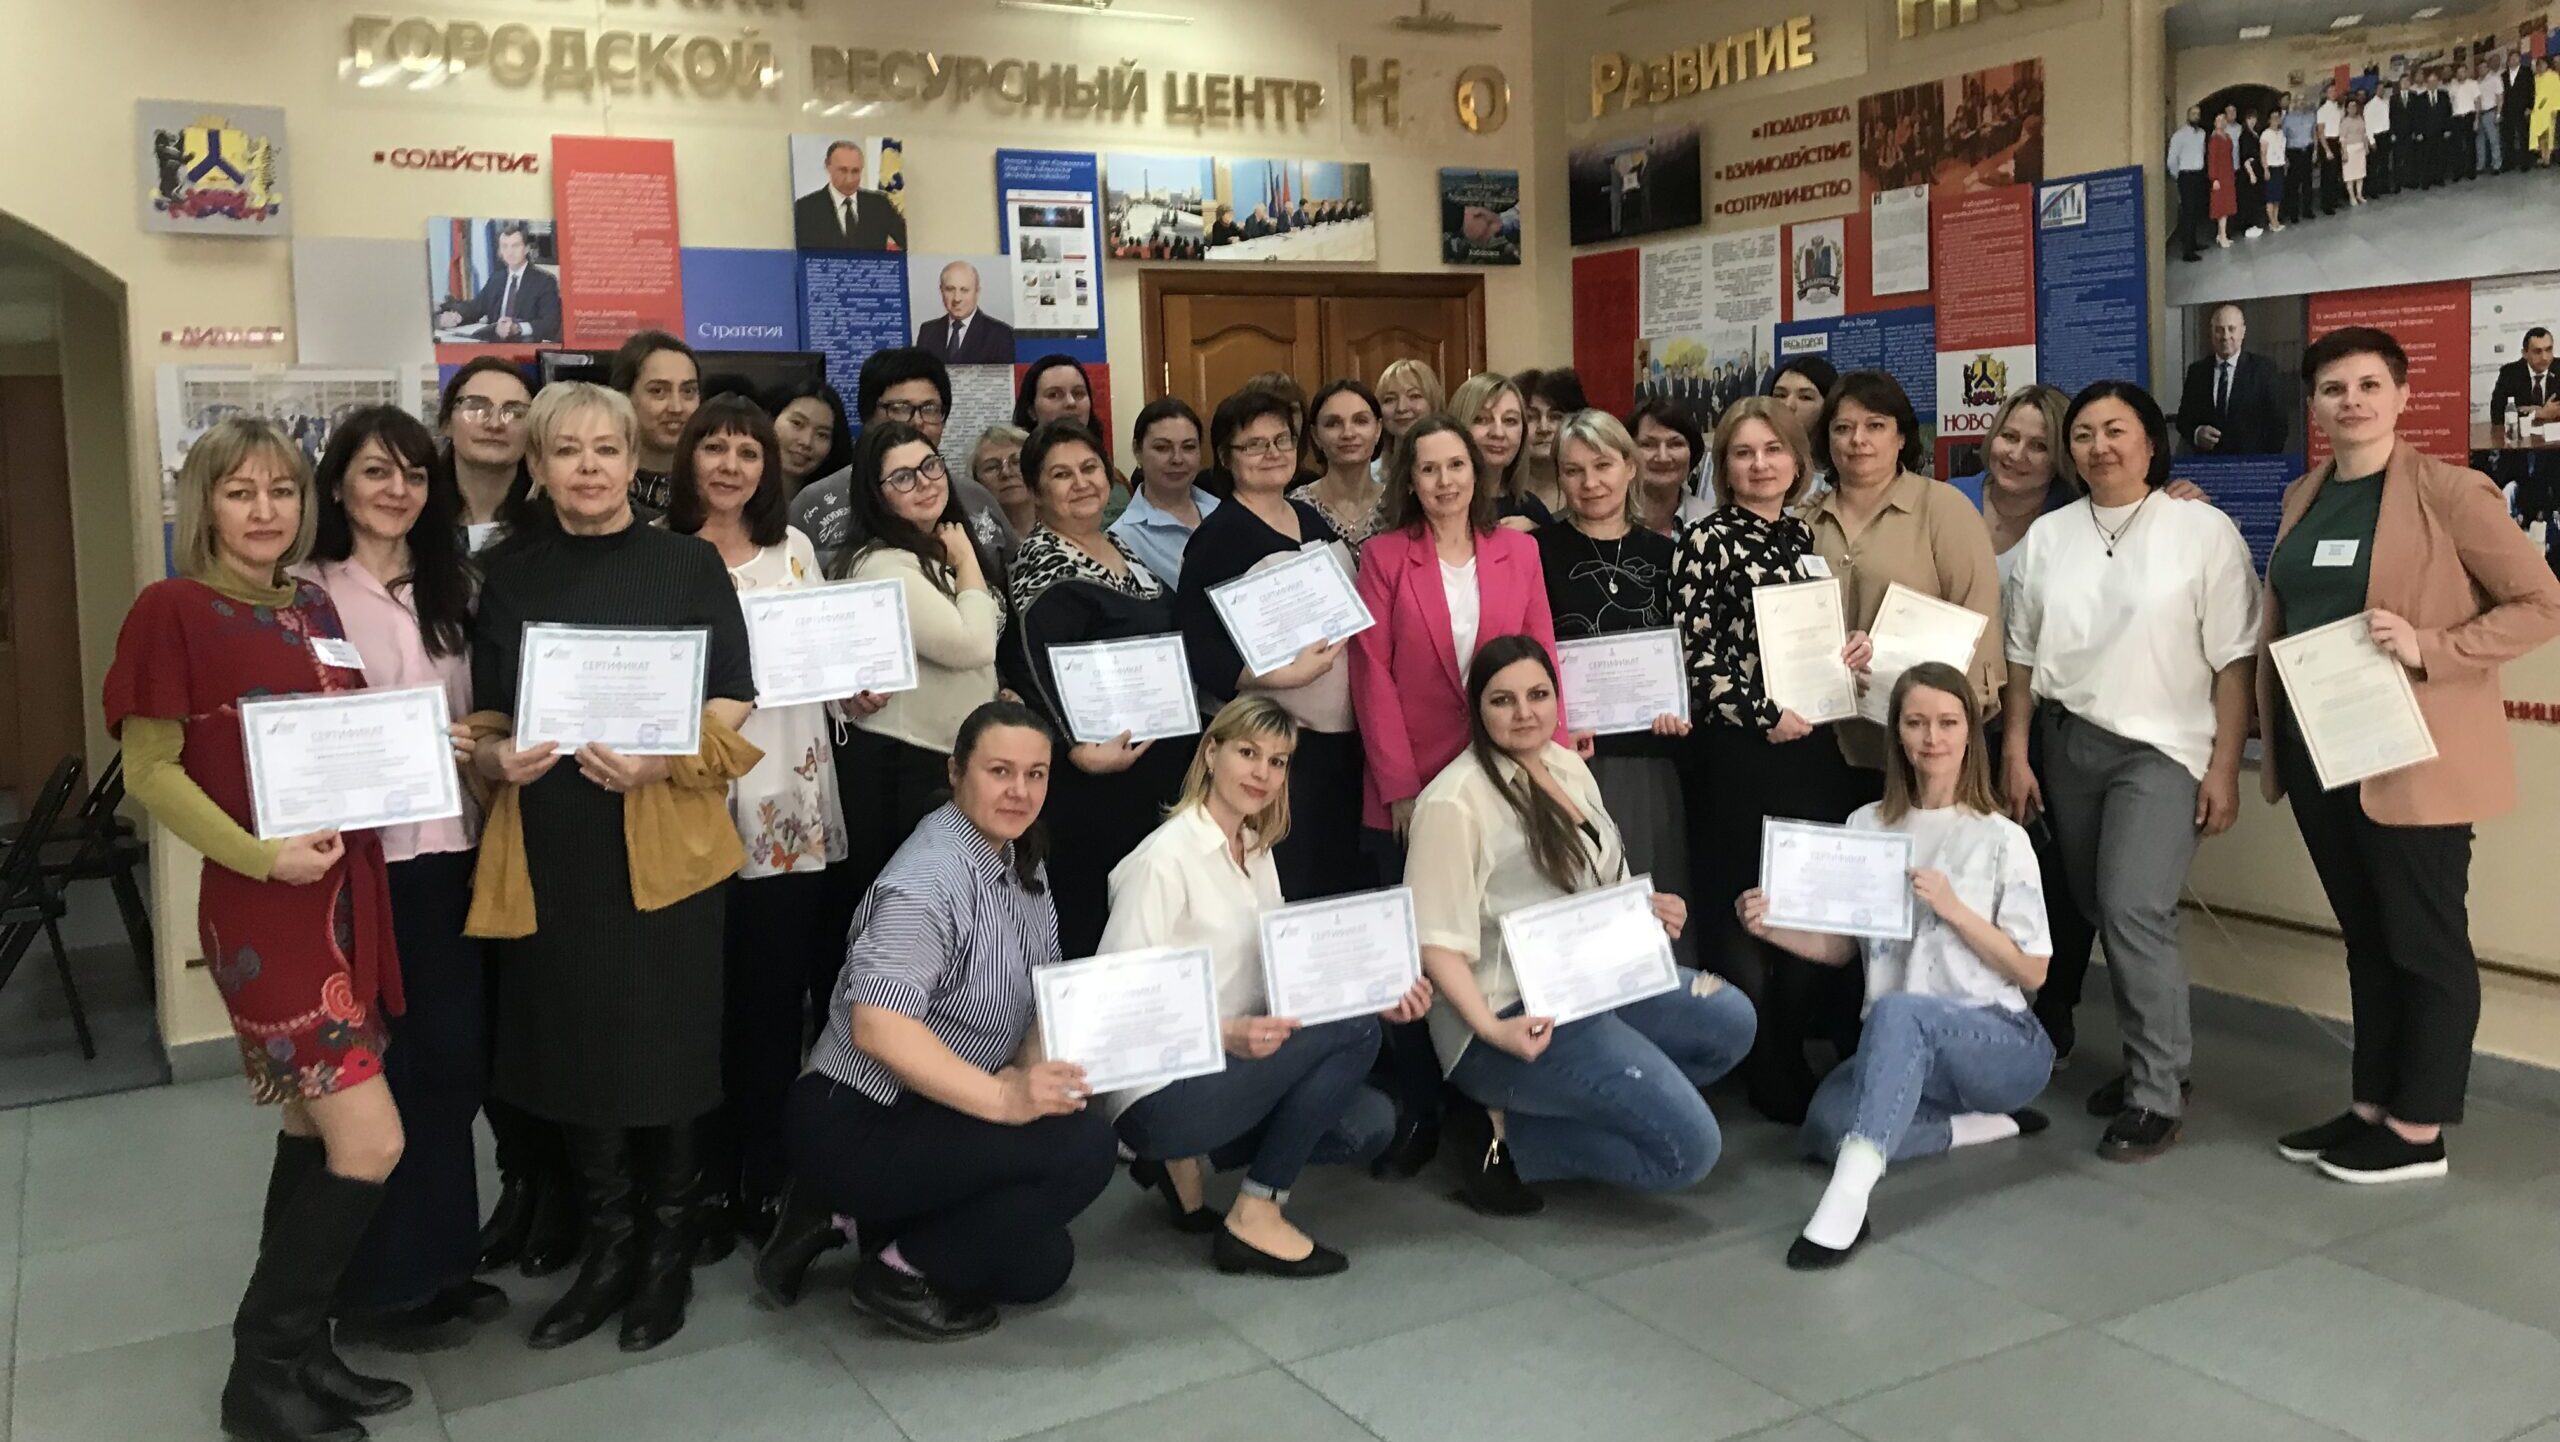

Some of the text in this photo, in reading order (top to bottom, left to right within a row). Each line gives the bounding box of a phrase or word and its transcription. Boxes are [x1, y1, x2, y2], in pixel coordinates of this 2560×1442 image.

[346, 14, 778, 99] ГОРОДСКОЙ
[810, 45, 1147, 119] РЕСУРСНЫЙ
[1165, 68, 1326, 125] ЦЕНТР
[1590, 15, 1816, 117] РАЗВИТИЕ
[1763, 105, 1851, 139] ПОДДЕРЖКА
[390, 145, 540, 173] СОДЕЙСТВИЕ
[1725, 140, 1853, 180] ВЗАИМОДЕЙСТВИЕ
[1724, 178, 1852, 214] СОТРУДНИЧЕСТВО
[698, 322, 783, 340] Стратегия
[1944, 412, 1994, 432] НОВО
[581, 660, 651, 672] СЕРТИФИКАТ
